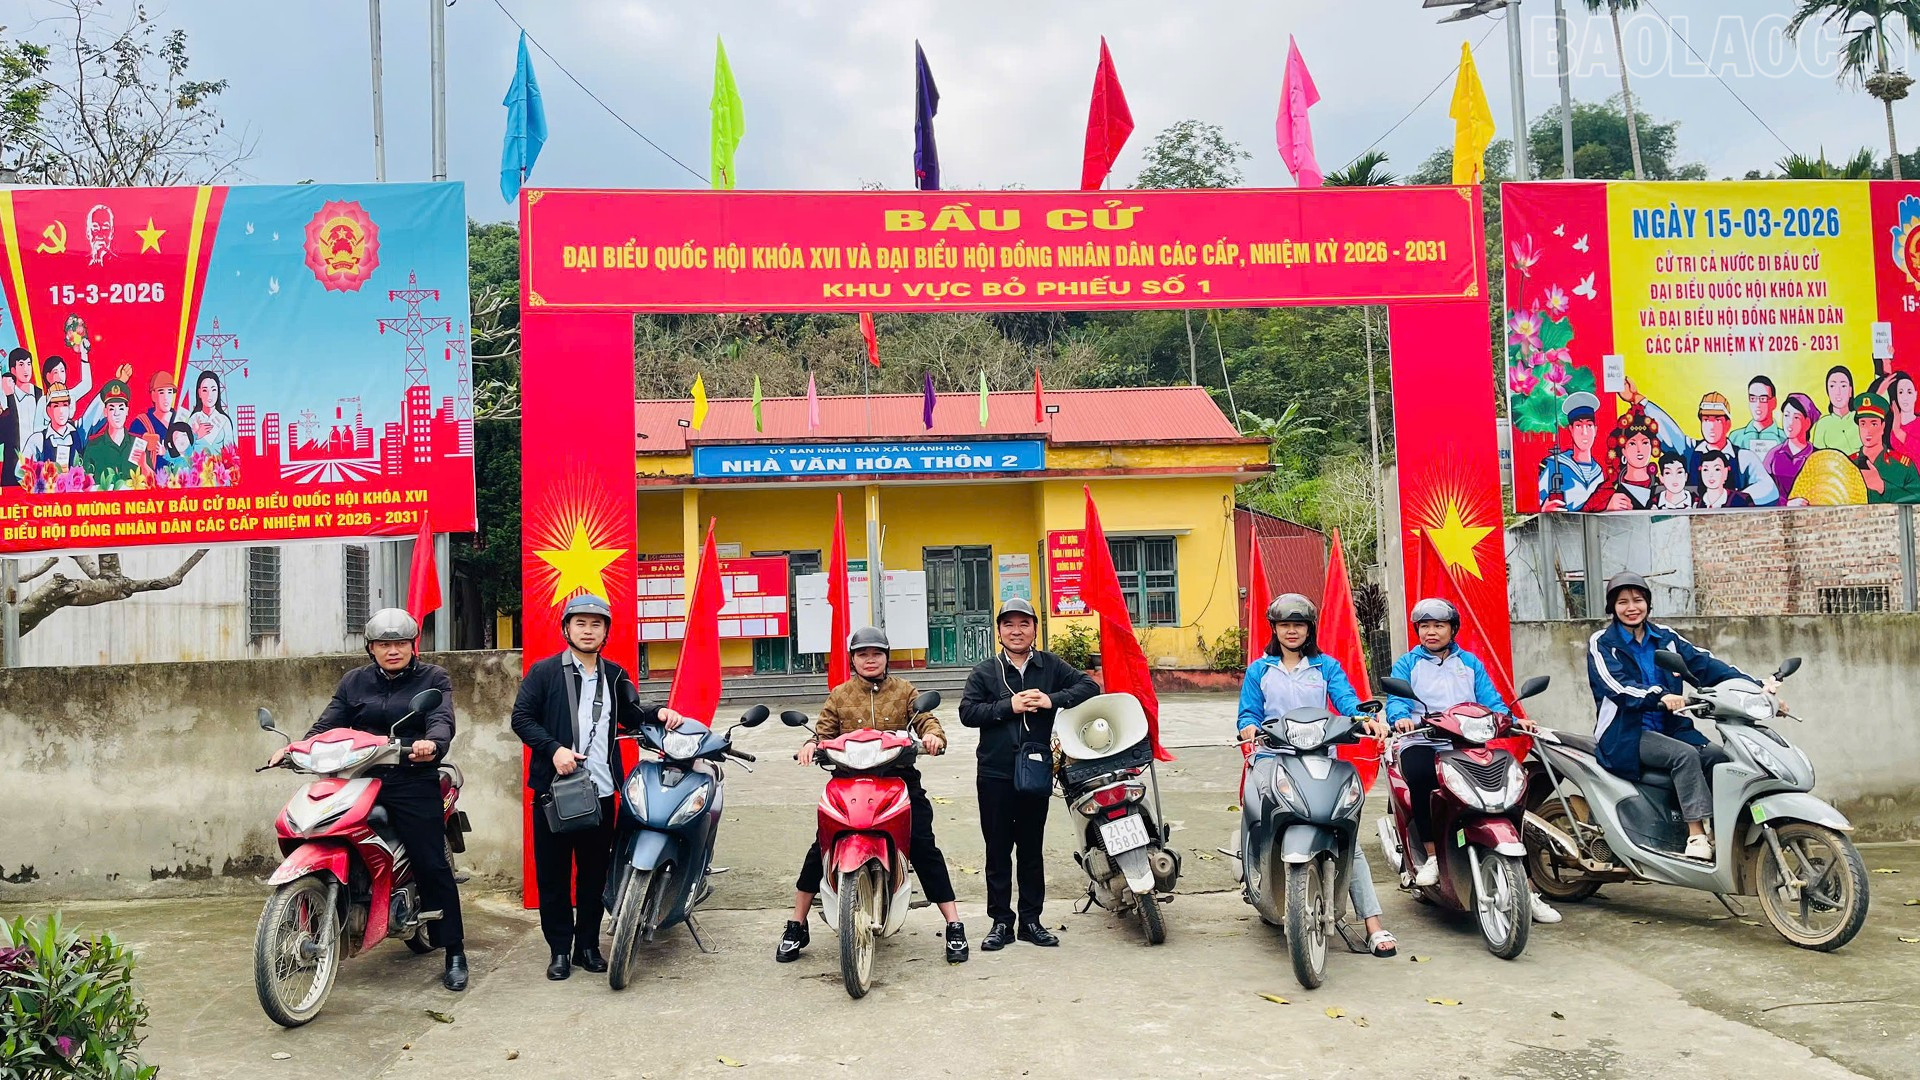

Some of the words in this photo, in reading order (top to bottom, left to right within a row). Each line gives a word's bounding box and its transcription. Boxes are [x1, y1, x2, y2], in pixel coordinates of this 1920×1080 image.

[885, 202, 1021, 231] BẦU
[1046, 200, 1144, 231] CỬ
[1633, 202, 1696, 239] NGÀY
[1704, 207, 1840, 238] 15-03-2026
[563, 246, 597, 272] ĐẠI
[603, 238, 648, 269] BIỂU
[655, 239, 707, 271] QUỐC
[713, 243, 746, 273] HỘI
[752, 243, 805, 269] KHÓA
[810, 247, 841, 269] XVI
[847, 243, 872, 269] VÀ
[876, 247, 909, 273] ĐẠI
[915, 238, 958, 269] BIỂU
[964, 243, 996, 272] HỘI
[1000, 239, 1052, 268] ĐỒNG
[1058, 241, 1110, 267] NHÂN
[1116, 241, 1154, 267] DÂN
[1160, 241, 1197, 266] CÁC
[1202, 237, 1246, 267] CẤP,
[1250, 239, 1311, 269] NHIỆM
[1316, 238, 1339, 264] KỲ
[1344, 241, 1388, 263] 2026
[1405, 240, 1447, 262] 2031
[1656, 250, 1674, 273] CỬ
[1677, 255, 1697, 272] TRI
[1700, 249, 1718, 272] CẢ
[1720, 251, 1755, 272] NƯỚC
[1758, 254, 1771, 271] ĐI
[1774, 249, 1799, 271] BẦU
[1802, 248, 1820, 271] CỬ
[49, 282, 165, 305] 15-3-2026
[822, 282, 892, 298] KHU
[902, 281, 972, 300] VỰC
[982, 276, 1027, 297] BỎ
[1036, 275, 1131, 296] PHIẾU
[1142, 274, 1186, 294] SỐ
[1197, 280, 1211, 293] 1
[1650, 283, 1672, 303] ĐẠI
[1675, 276, 1705, 300] BIỂU
[1708, 277, 1743, 301] QUỐC
[1745, 279, 1767, 302] HỘI
[1770, 279, 1802, 298] KHÓA
[1807, 281, 1827, 298] XVI
[1902, 295, 1920, 312] 15-
[1640, 306, 1656, 327] VÀ
[1659, 310, 1681, 331] ĐẠI
[1685, 303, 1714, 327] BIỂU
[1717, 306, 1739, 329] HỘI
[1742, 303, 1777, 326] ĐỒNG
[1780, 305, 1815, 325] NHÂN
[1818, 305, 1844, 325] DÂN
[1646, 334, 1672, 355] CÁC
[1675, 331, 1701, 354] CẤP
[1704, 334, 1745, 357] NHIỆM
[1748, 332, 1765, 352] KỲ
[1768, 336, 1799, 352] 2026
[1810, 335, 1840, 351] 2031
[721, 457, 782, 473] NHÀ
[789, 456, 847, 471] VĂN
[855, 455, 913, 470] HÓA
[919, 453, 993, 469] THÔN
[1001, 455, 1019, 467] 2
[769, 447, 787, 455] UỶ
[817, 445, 852, 454] NHÂN
[854, 445, 880, 453] DÂN
[883, 445, 900, 453] XÃ
[0, 503, 29, 522] LIỆT
[33, 502, 72, 518] CHÀO
[76, 500, 121, 517] MỪNG
[125, 498, 166, 515] NGÀY
[168, 495, 199, 513] BẦU
[203, 494, 224, 511] CỬ
[226, 497, 251, 513] ĐẠI
[255, 490, 288, 509] BIỂU
[292, 490, 331, 508] QUỐC
[335, 491, 359, 509] HỘI
[363, 489, 401, 504] KHÓA
[405, 489, 428, 502] XVI
[4, 521, 38, 540] BIỂU
[41, 523, 66, 541] HỘI
[70, 520, 111, 538] ĐỒNG
[114, 521, 157, 537] NHÂN
[161, 518, 192, 534] DÂN
[196, 516, 226, 532] CÁC
[229, 513, 259, 531] CẤP
[263, 513, 311, 531] NHIỆM
[314, 511, 333, 528] KỲ
[337, 512, 372, 526] 2026
[385, 510, 419, 524] 2031
[651, 563, 680, 572] BẢNG
[1108, 830, 1147, 853] 258.01
